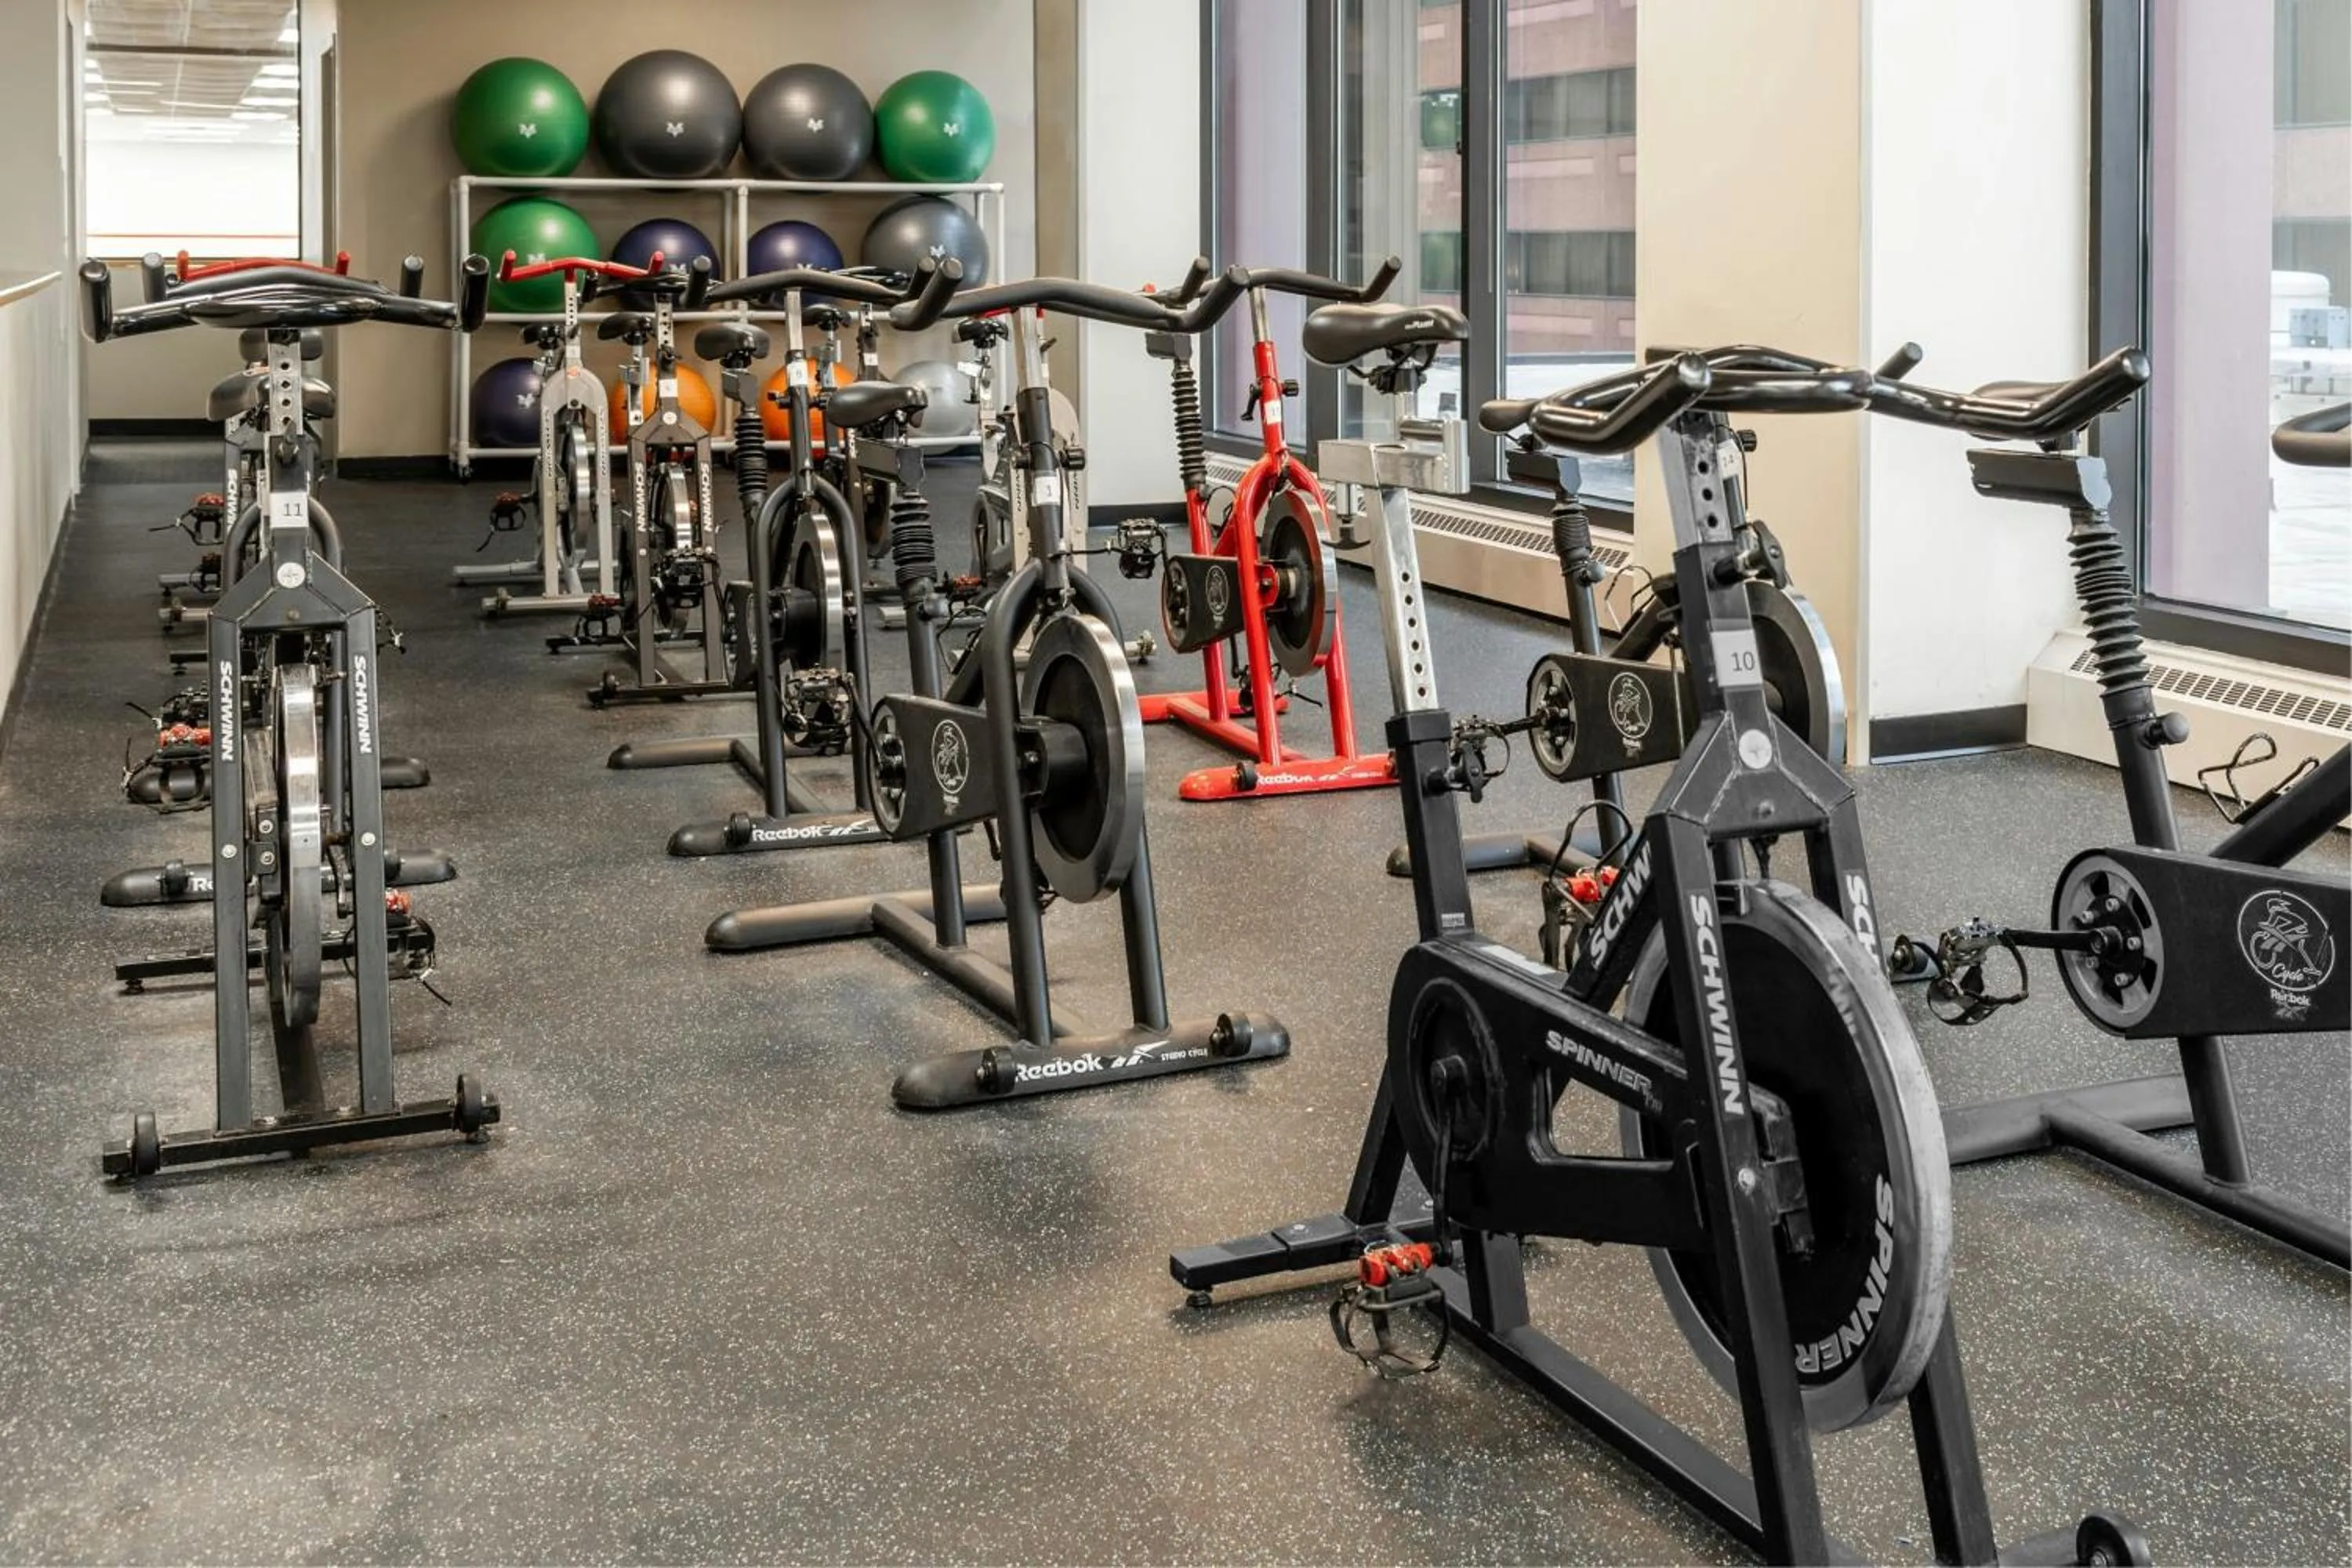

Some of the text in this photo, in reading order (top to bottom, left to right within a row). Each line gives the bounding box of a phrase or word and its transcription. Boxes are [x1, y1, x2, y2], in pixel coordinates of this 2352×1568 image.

[225, 469, 238, 534] SCHWI
[282, 502, 303, 517] 11
[354, 654, 372, 755] SCHWINN
[1730, 651, 1756, 672] 10
[219, 659, 234, 762] SCHWINN
[1590, 839, 1652, 971] SCHW
[1690, 894, 1745, 1116] SCHWINN
[1014, 1053, 1103, 1083] Reebok
[1545, 1029, 1653, 1101] SPINNER
[1795, 1172, 1894, 1373] SPINNER
